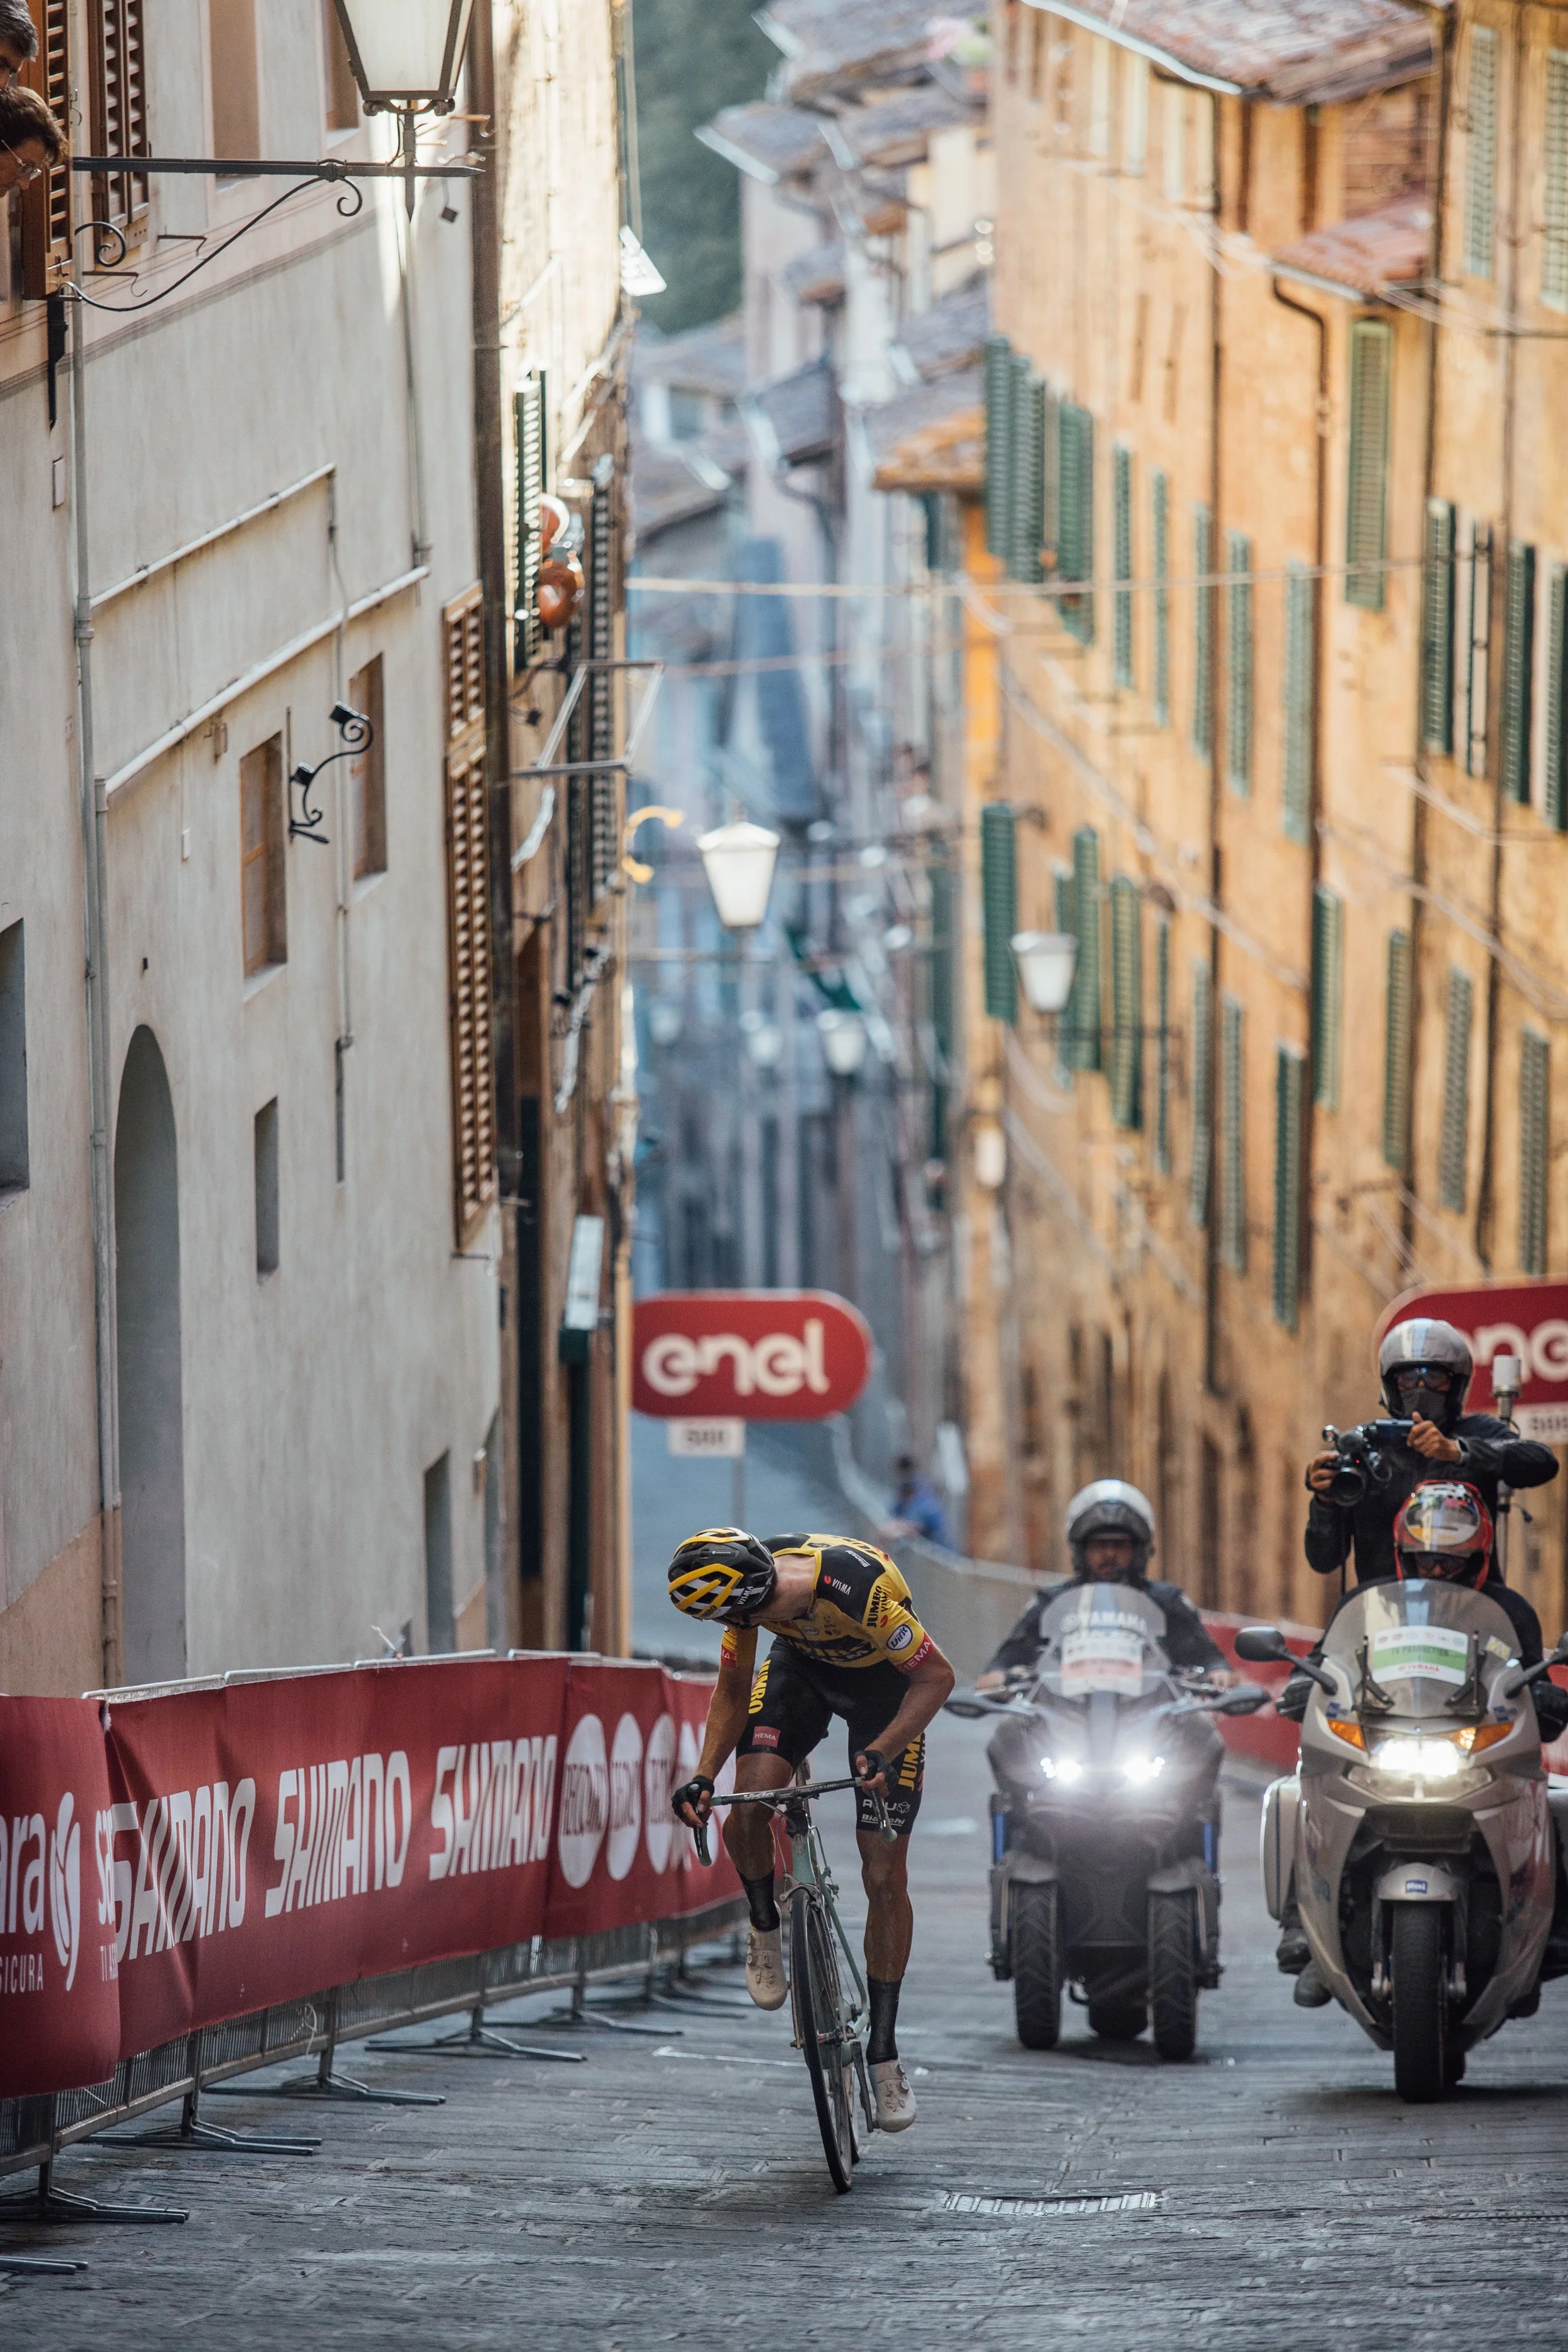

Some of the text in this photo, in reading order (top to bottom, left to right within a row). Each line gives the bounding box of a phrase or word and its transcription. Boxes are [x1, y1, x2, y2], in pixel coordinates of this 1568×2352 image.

[641, 1317, 830, 1398] enel
[1454, 1318, 1568, 1384] ne
[737, 1586, 753, 1605] VISMA
[832, 1578, 852, 1596] VISMA
[866, 1585, 883, 1629] JUMBO
[755, 1732, 776, 1741] HEMA
[861, 1813, 905, 1826] Biachi
[862, 1798, 898, 1811] AU
[265, 1751, 412, 1919] SHIMANO
[112, 1777, 257, 1964] SHIMANO
